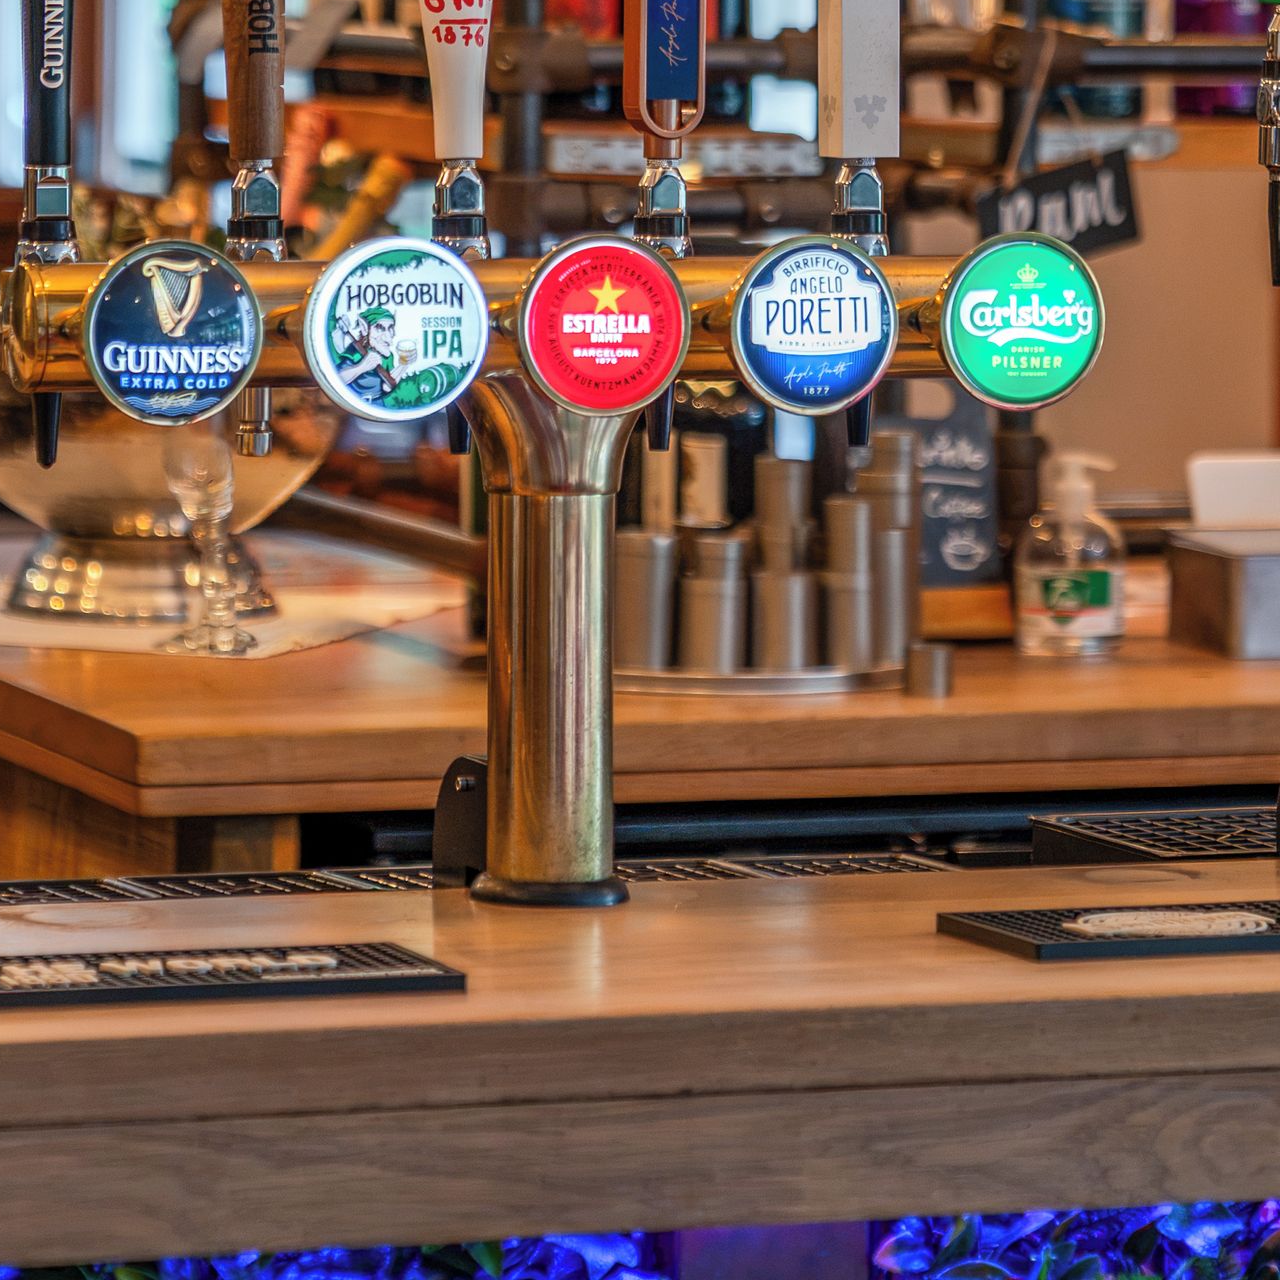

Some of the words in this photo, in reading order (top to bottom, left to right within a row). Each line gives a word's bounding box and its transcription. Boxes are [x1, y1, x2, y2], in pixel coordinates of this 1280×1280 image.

[431, 26, 485, 48] 1876
[783, 257, 849, 278] BIRRIFICIO
[790, 276, 843, 295] ANGELO
[346, 283, 464, 312] HOBGOBLIN
[421, 316, 462, 329] SESSION
[562, 314, 651, 334] ESTRELLA
[766, 297, 869, 336] PORETTI
[959, 289, 1094, 347] Carlsberg
[423, 330, 463, 360] IPA
[589, 333, 623, 343] DAMM
[103, 340, 246, 375] GUINNESS
[572, 347, 639, 358] BARCELONA
[643, 339, 663, 369] DAMM
[991, 356, 1063, 369] PILSNER
[121, 377, 177, 390] EXTRA
[184, 377, 228, 390] COLD
[803, 387, 830, 396] 1877
[99, 953, 337, 976] WORLD
